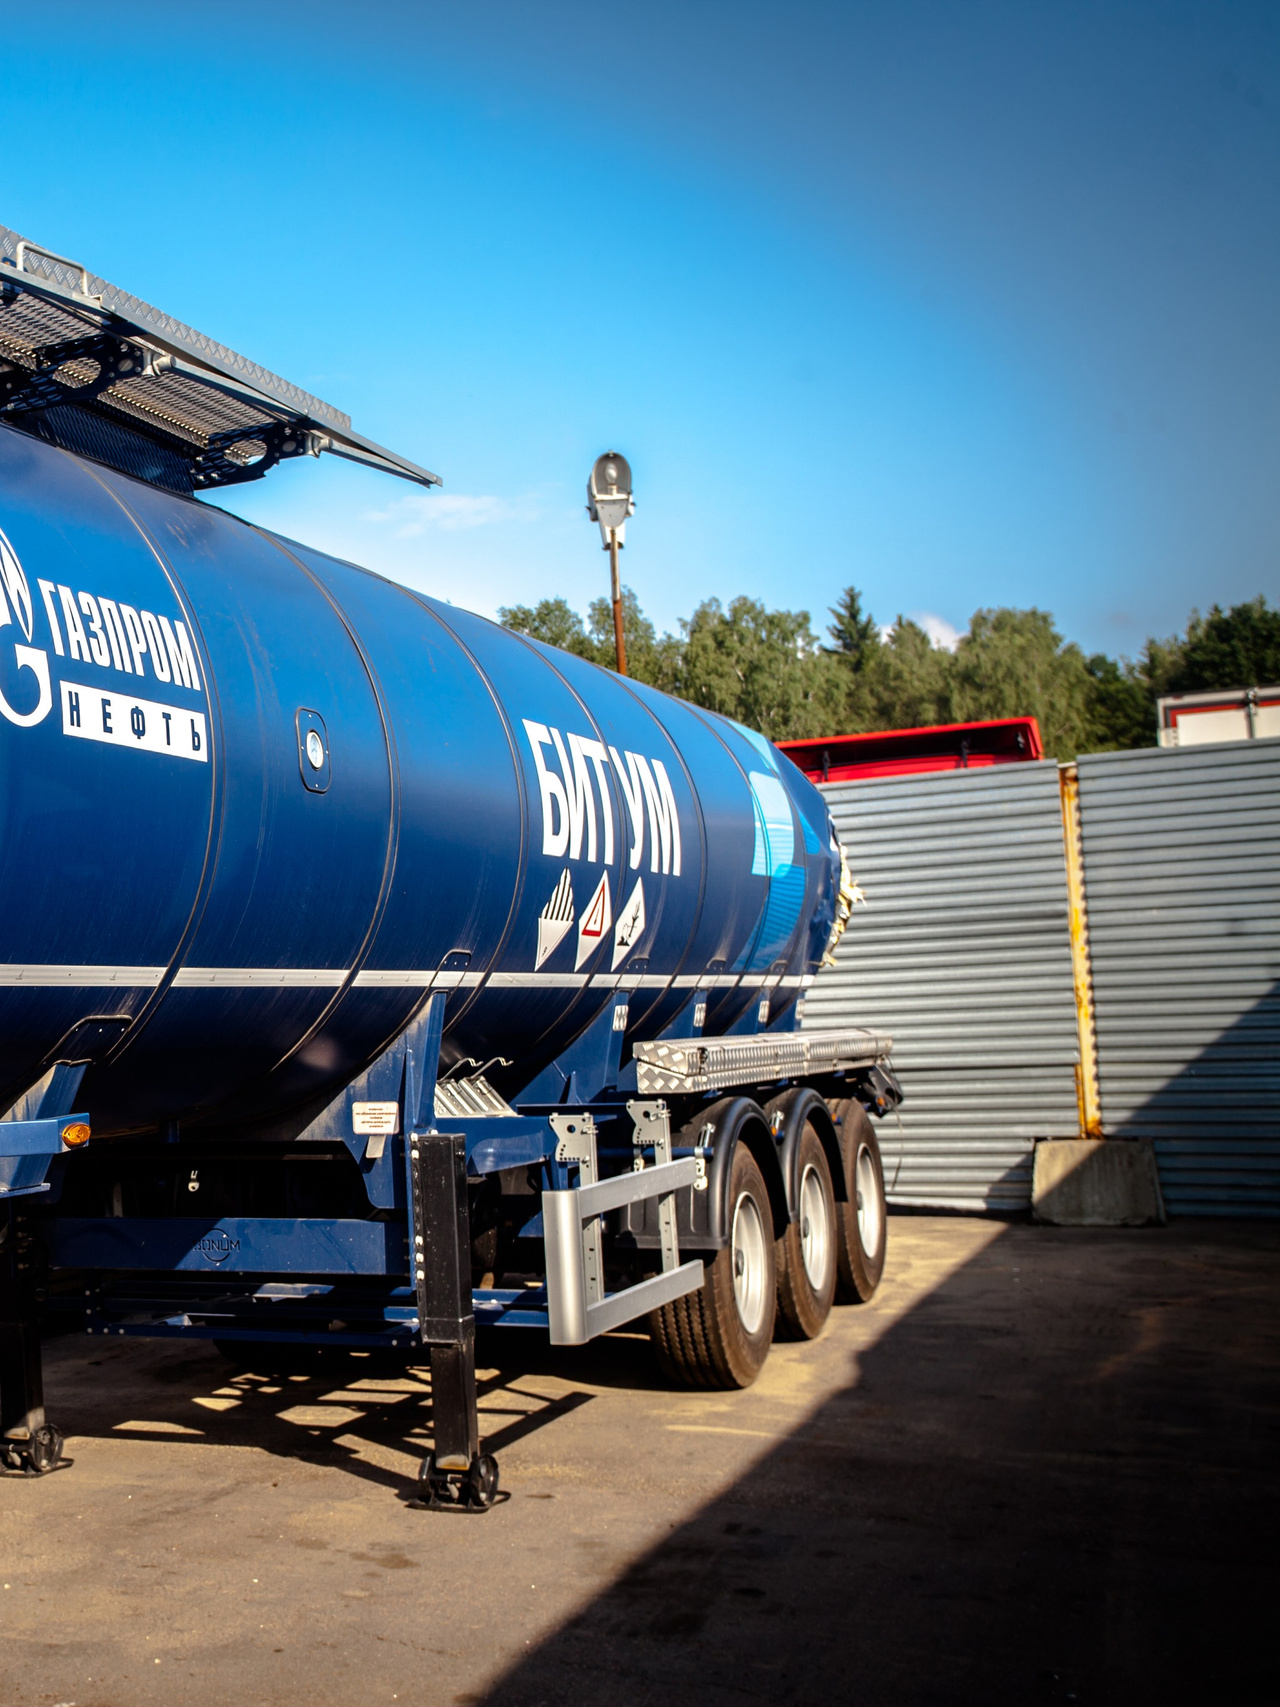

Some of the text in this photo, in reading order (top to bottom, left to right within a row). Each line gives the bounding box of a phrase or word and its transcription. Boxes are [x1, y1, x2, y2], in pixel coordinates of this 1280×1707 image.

[37, 578, 201, 691] ГАЗПРОМ
[68, 690, 201, 752] НЕФТЬ
[522, 718, 681, 877] БИТУМ
